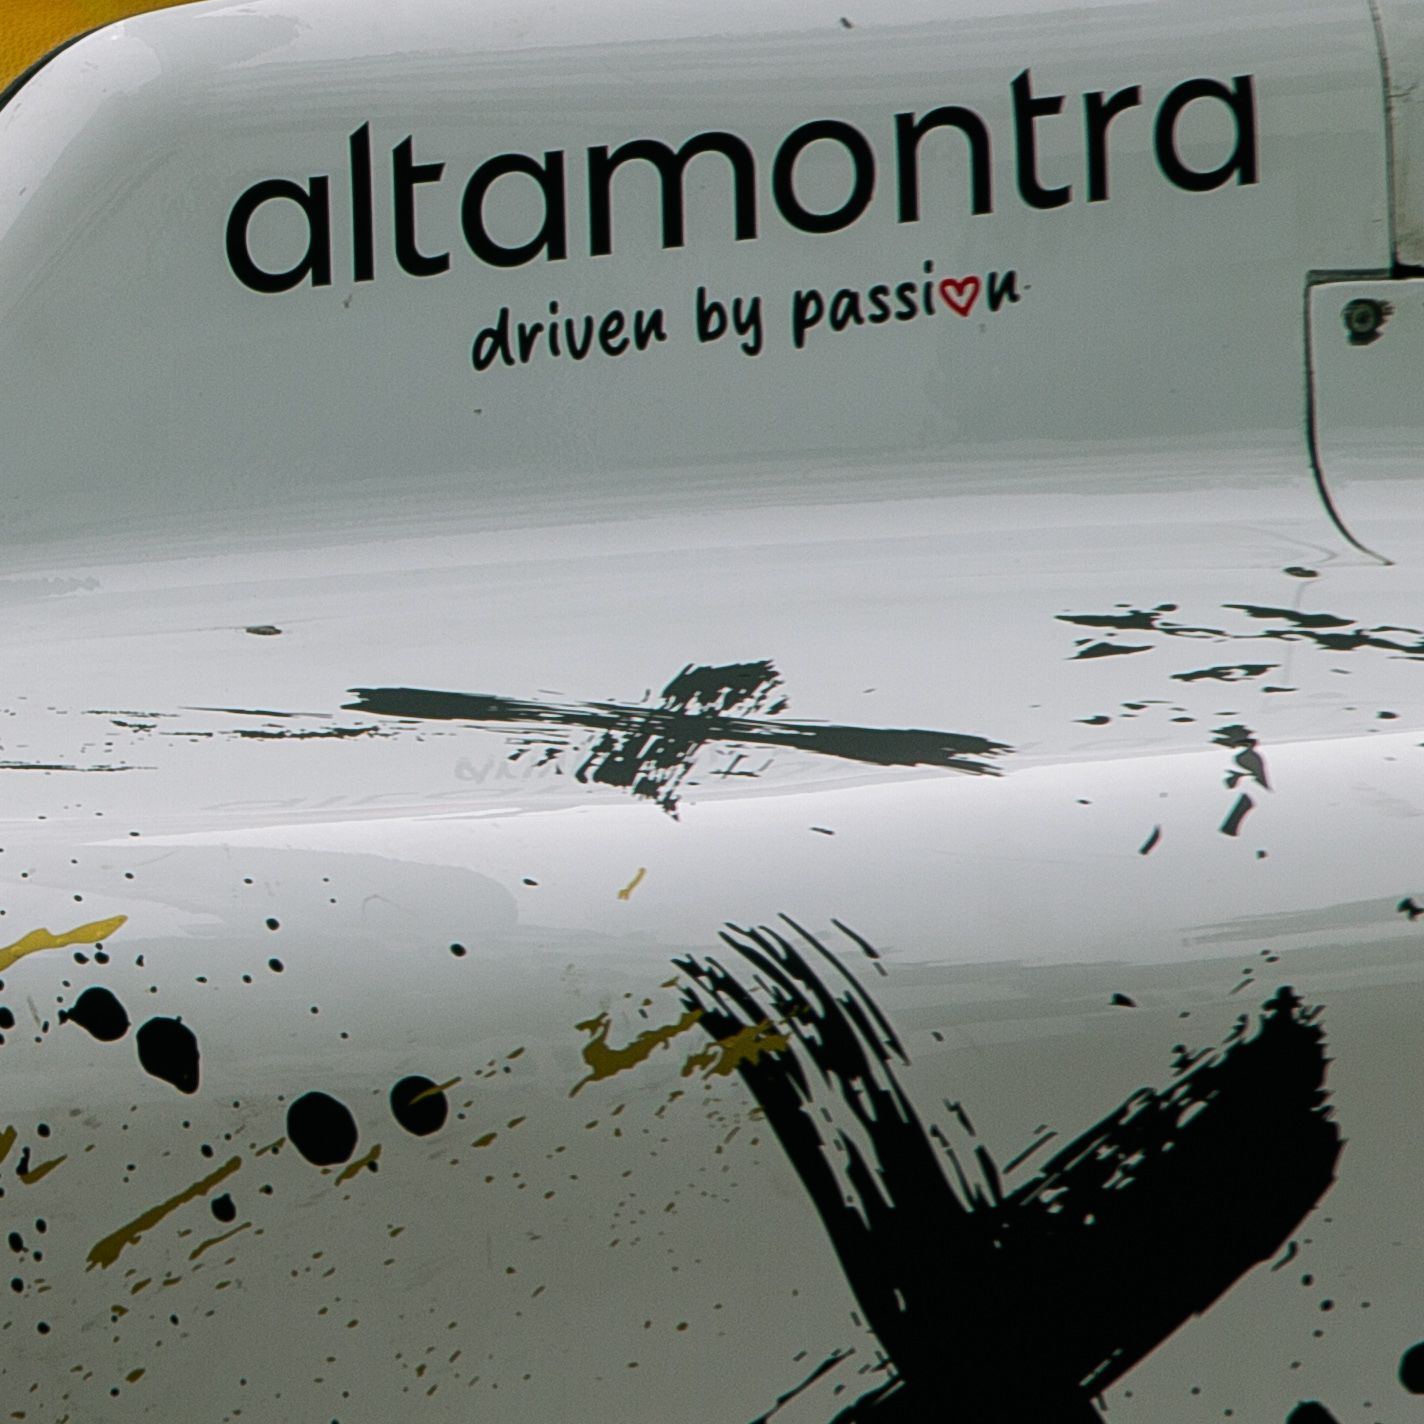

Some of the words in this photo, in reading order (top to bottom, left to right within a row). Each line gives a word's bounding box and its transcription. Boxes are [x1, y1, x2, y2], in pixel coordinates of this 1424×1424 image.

[224, 67, 1260, 294] altamontra
[470, 301, 668, 372] driven
[695, 286, 763, 357] by
